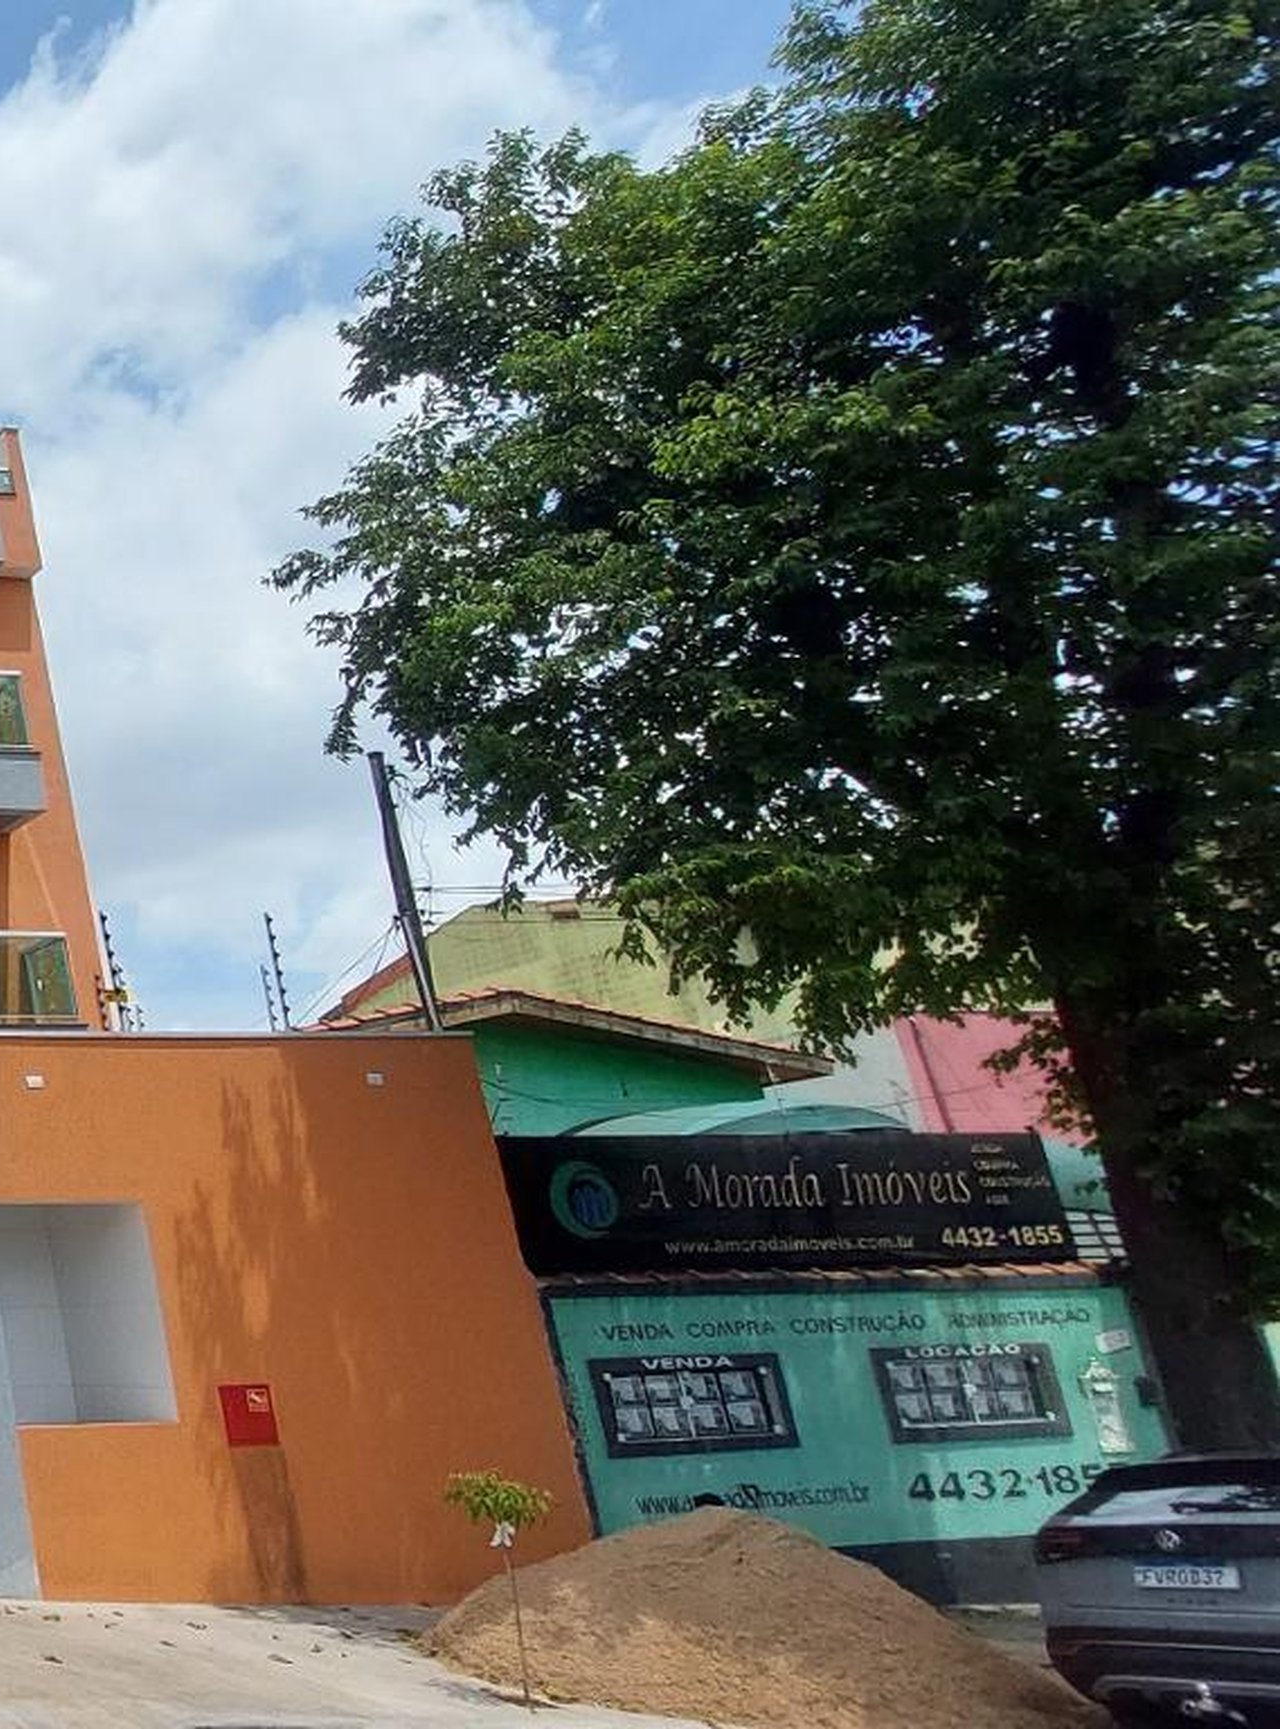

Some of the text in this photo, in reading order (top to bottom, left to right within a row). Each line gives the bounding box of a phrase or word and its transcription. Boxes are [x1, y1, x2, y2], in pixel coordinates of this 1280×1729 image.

[638, 1156, 972, 1208] A Morada Imóveis
[942, 1225, 1064, 1246] 4432-1855
[601, 1323, 675, 1341] VENDA
[686, 1320, 776, 1338] COMPRA
[790, 1310, 926, 1335] CONSTRUÇÃO
[642, 1356, 734, 1370] VENDA
